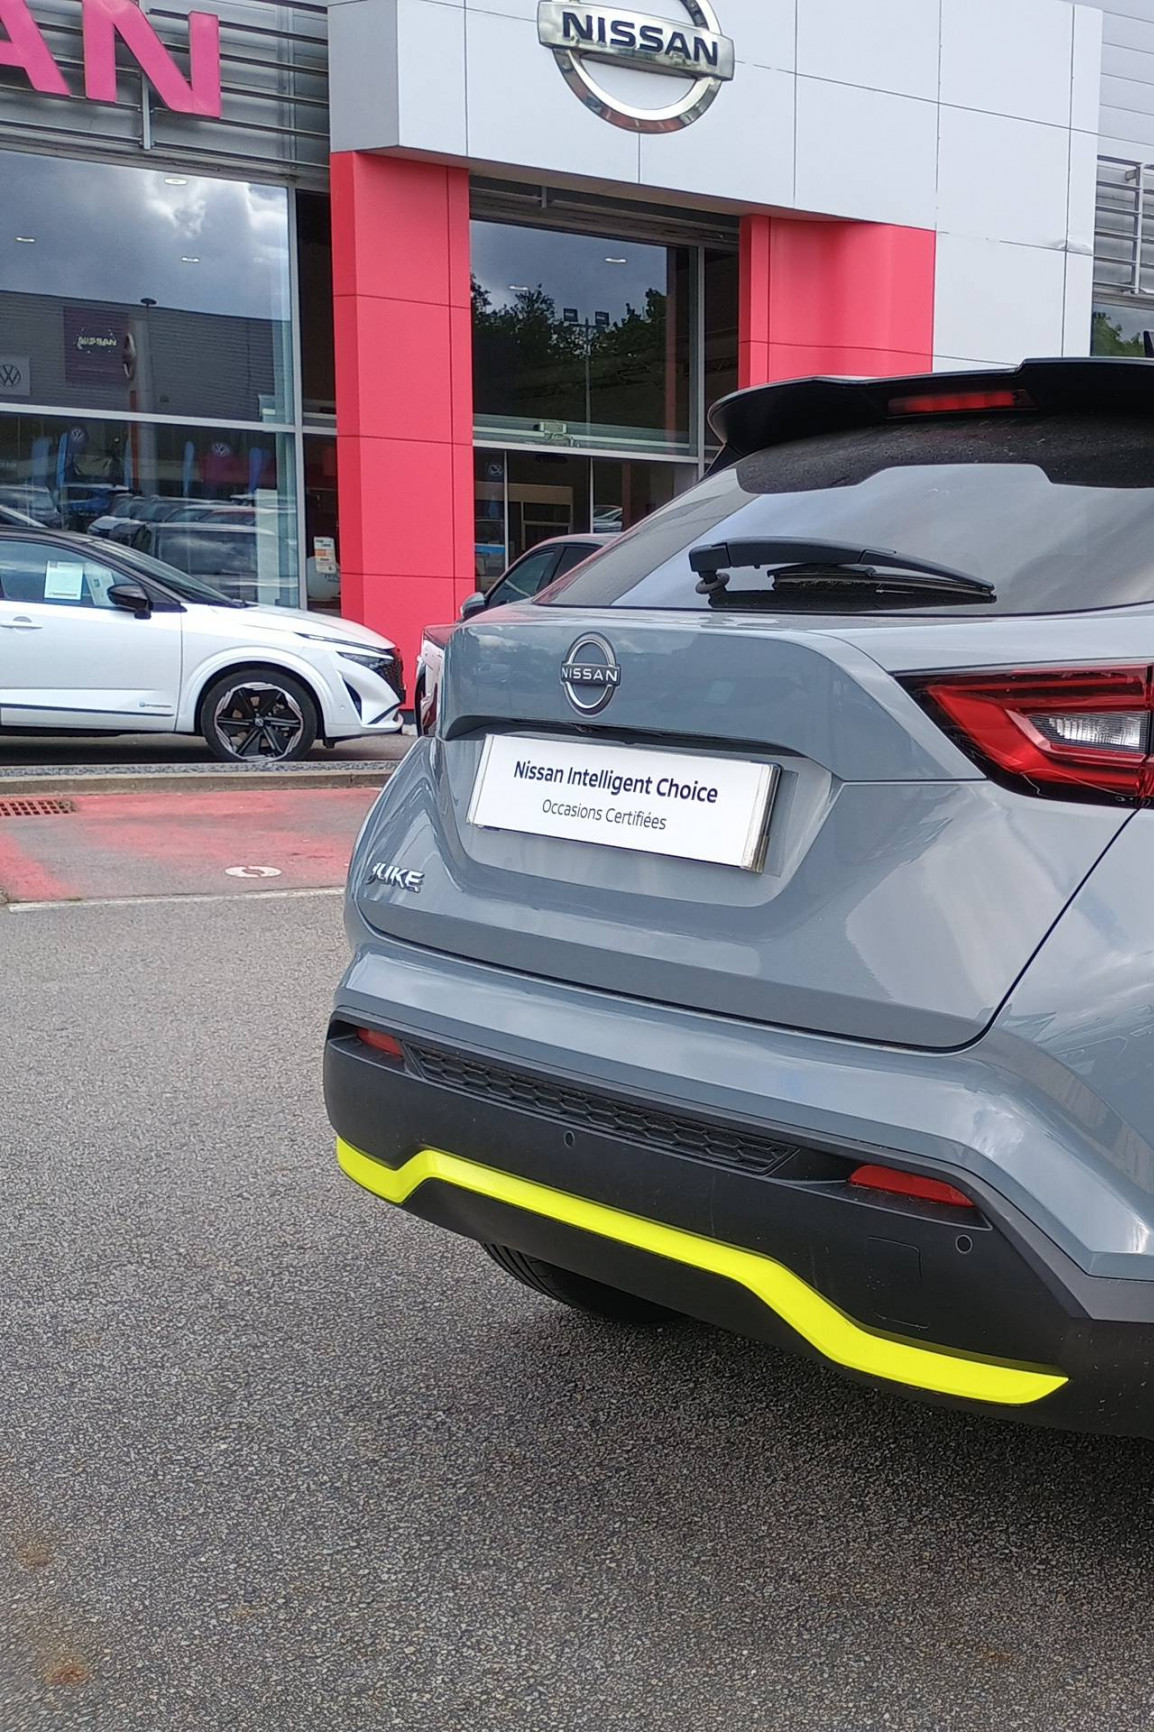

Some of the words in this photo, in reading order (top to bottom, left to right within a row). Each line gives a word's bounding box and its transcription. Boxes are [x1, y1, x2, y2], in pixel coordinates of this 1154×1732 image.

[562, 11, 718, 66] NISSAN
[561, 667, 618, 683] NISSAN
[513, 760, 563, 783] Nissan
[566, 767, 653, 796] Intelligent
[656, 778, 718, 804] Choice
[542, 799, 602, 821] Occasions
[605, 808, 667, 831] Certifiées
[367, 862, 425, 893] JUKE
